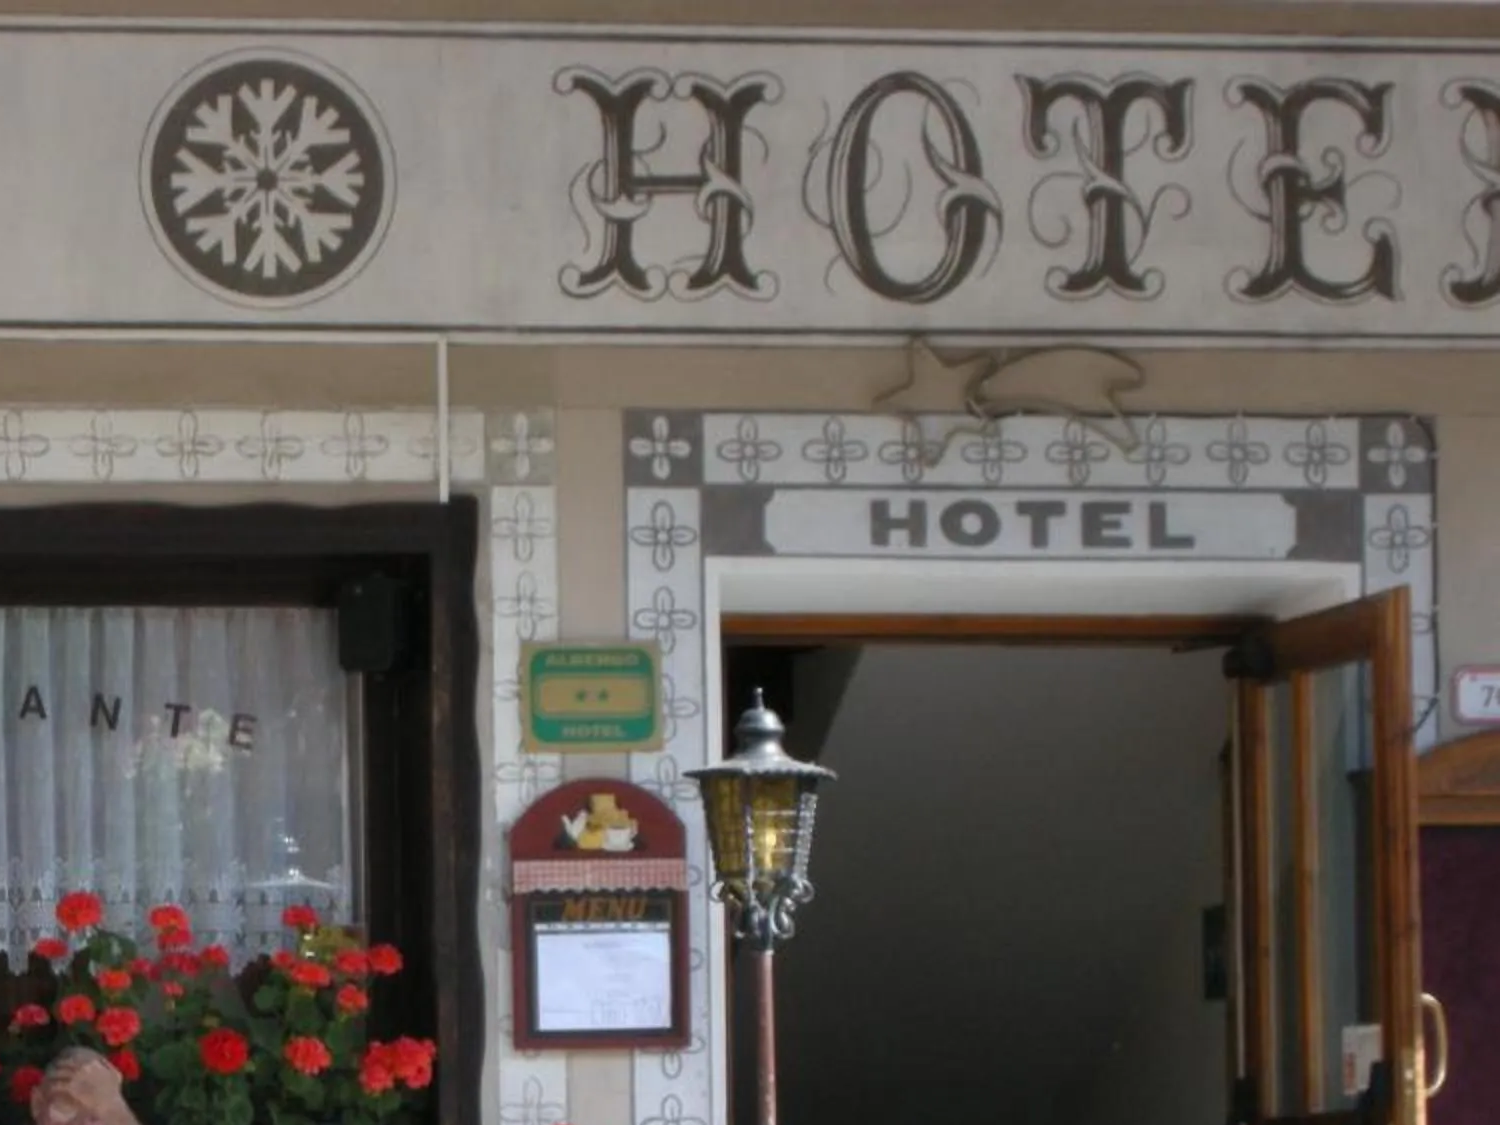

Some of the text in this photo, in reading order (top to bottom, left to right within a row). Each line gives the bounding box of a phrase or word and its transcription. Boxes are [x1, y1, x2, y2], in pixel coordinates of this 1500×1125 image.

[869, 499, 1195, 549] HOTEL
[561, 723, 628, 739] HOTEL
[561, 896, 648, 921] MENU
